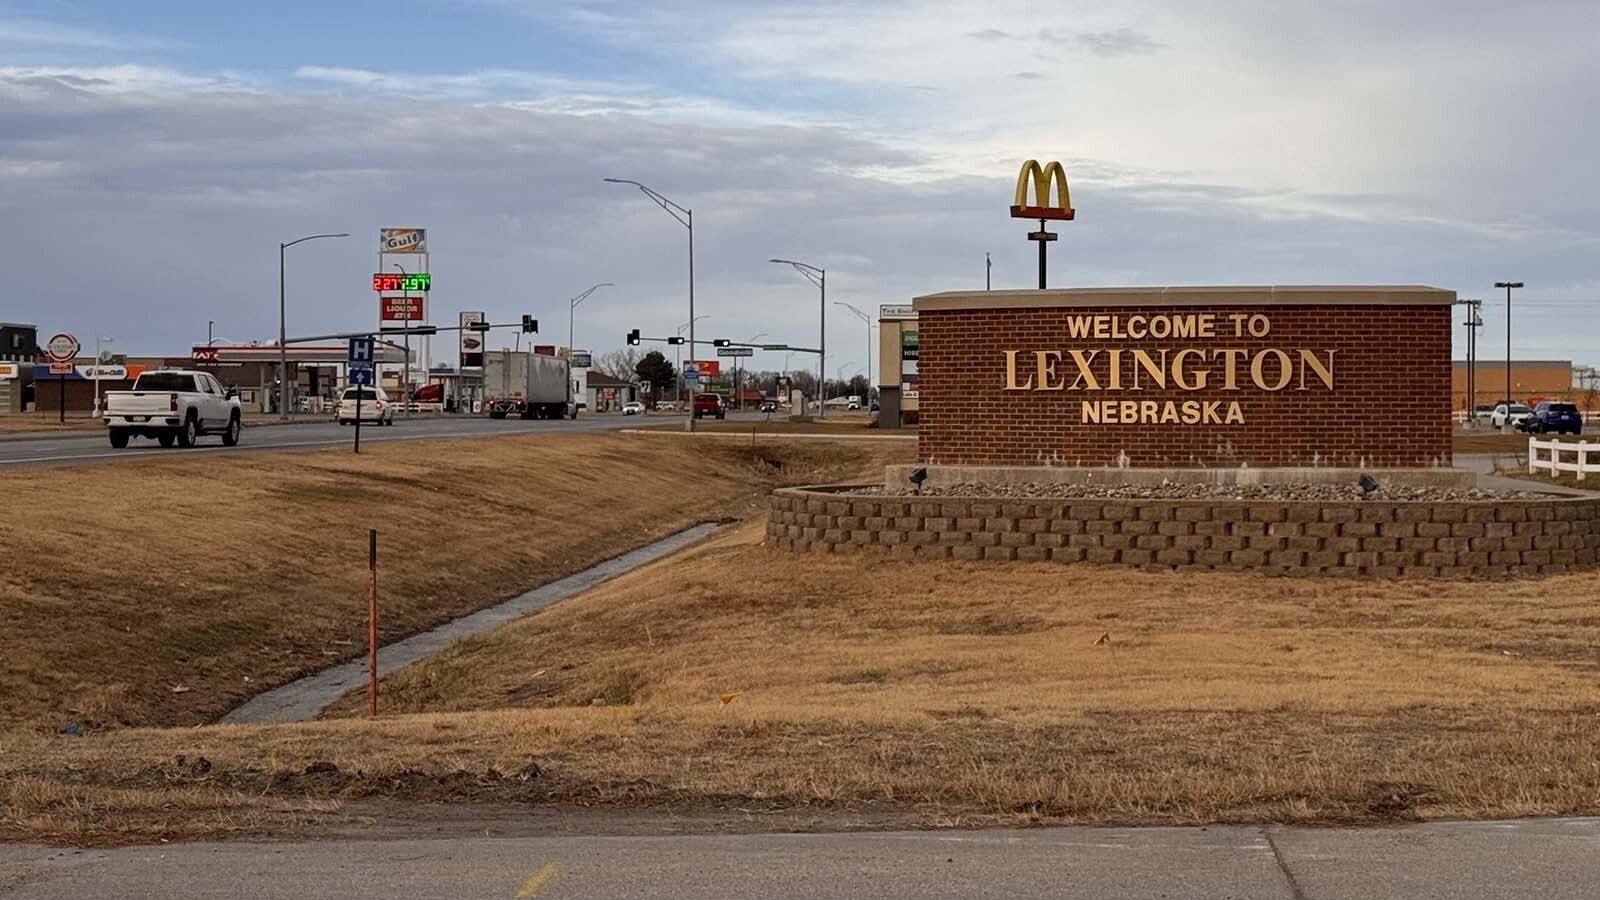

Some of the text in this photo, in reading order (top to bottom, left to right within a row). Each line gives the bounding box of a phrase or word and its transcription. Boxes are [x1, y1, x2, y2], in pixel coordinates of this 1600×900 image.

[387, 233, 418, 248] Gulf
[1067, 314, 1271, 339] WELCOME TO
[353, 340, 369, 360] H
[1002, 348, 1339, 391] LEXINGTON
[1081, 400, 1246, 424] NEBRASKA
